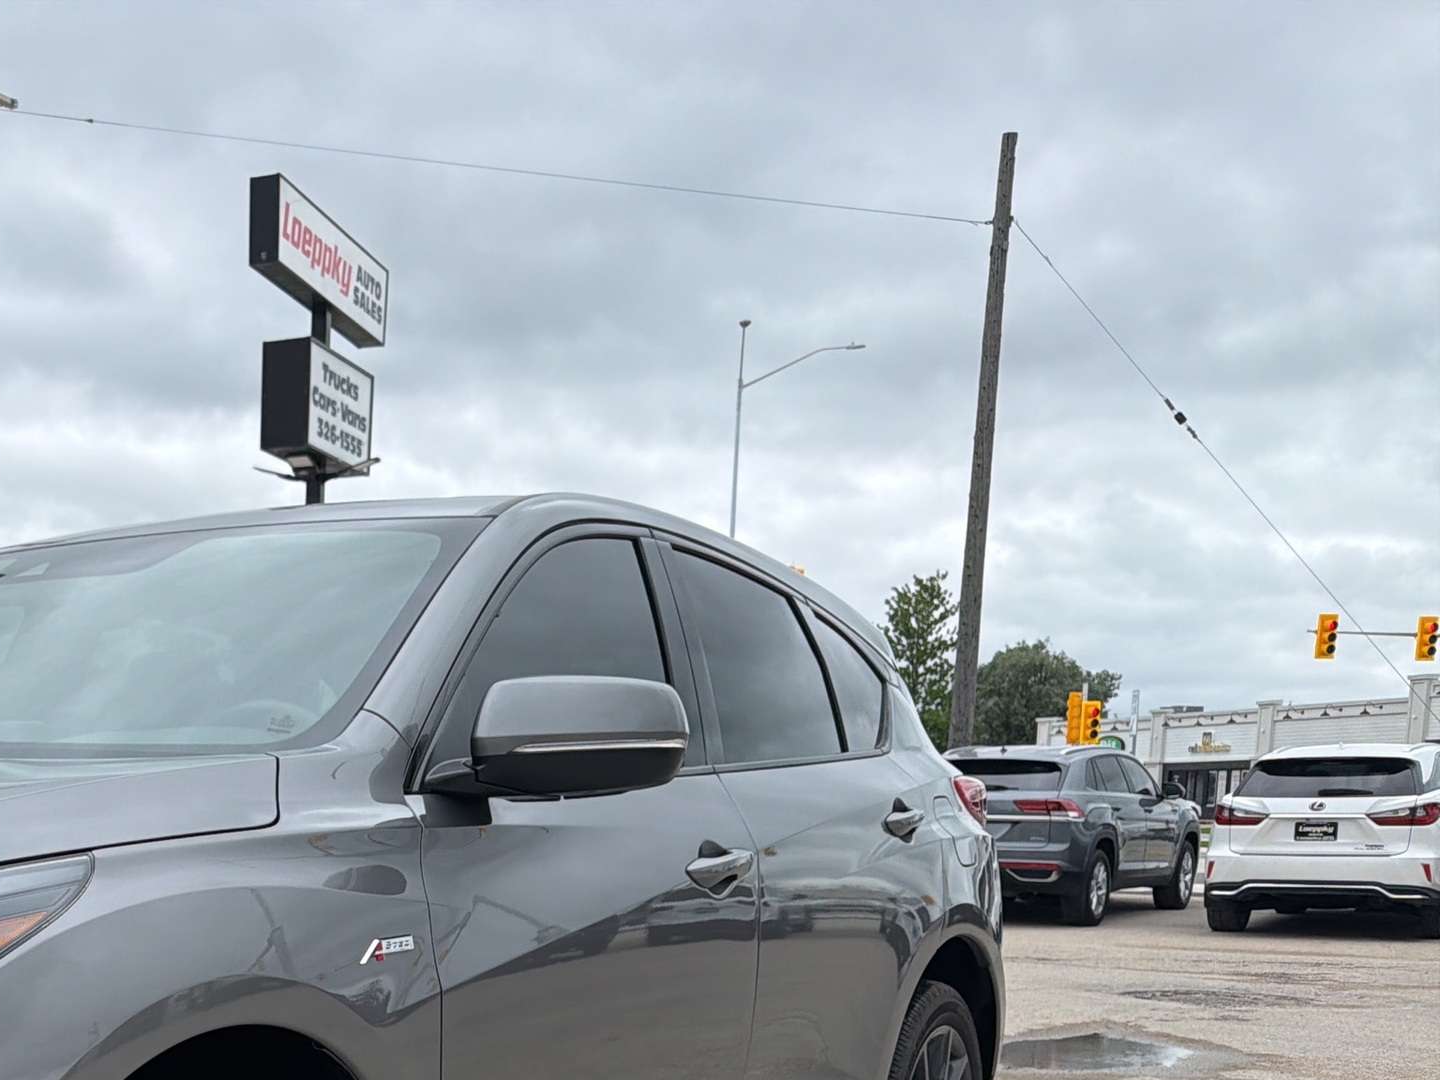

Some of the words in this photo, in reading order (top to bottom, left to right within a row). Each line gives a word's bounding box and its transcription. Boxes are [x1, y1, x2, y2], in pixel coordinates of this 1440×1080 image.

[282, 202, 352, 298] Loeppky
[356, 265, 382, 302] AUTO
[353, 287, 383, 326] SALES
[322, 361, 359, 402] Trucks
[317, 416, 362, 458] 326-1555
